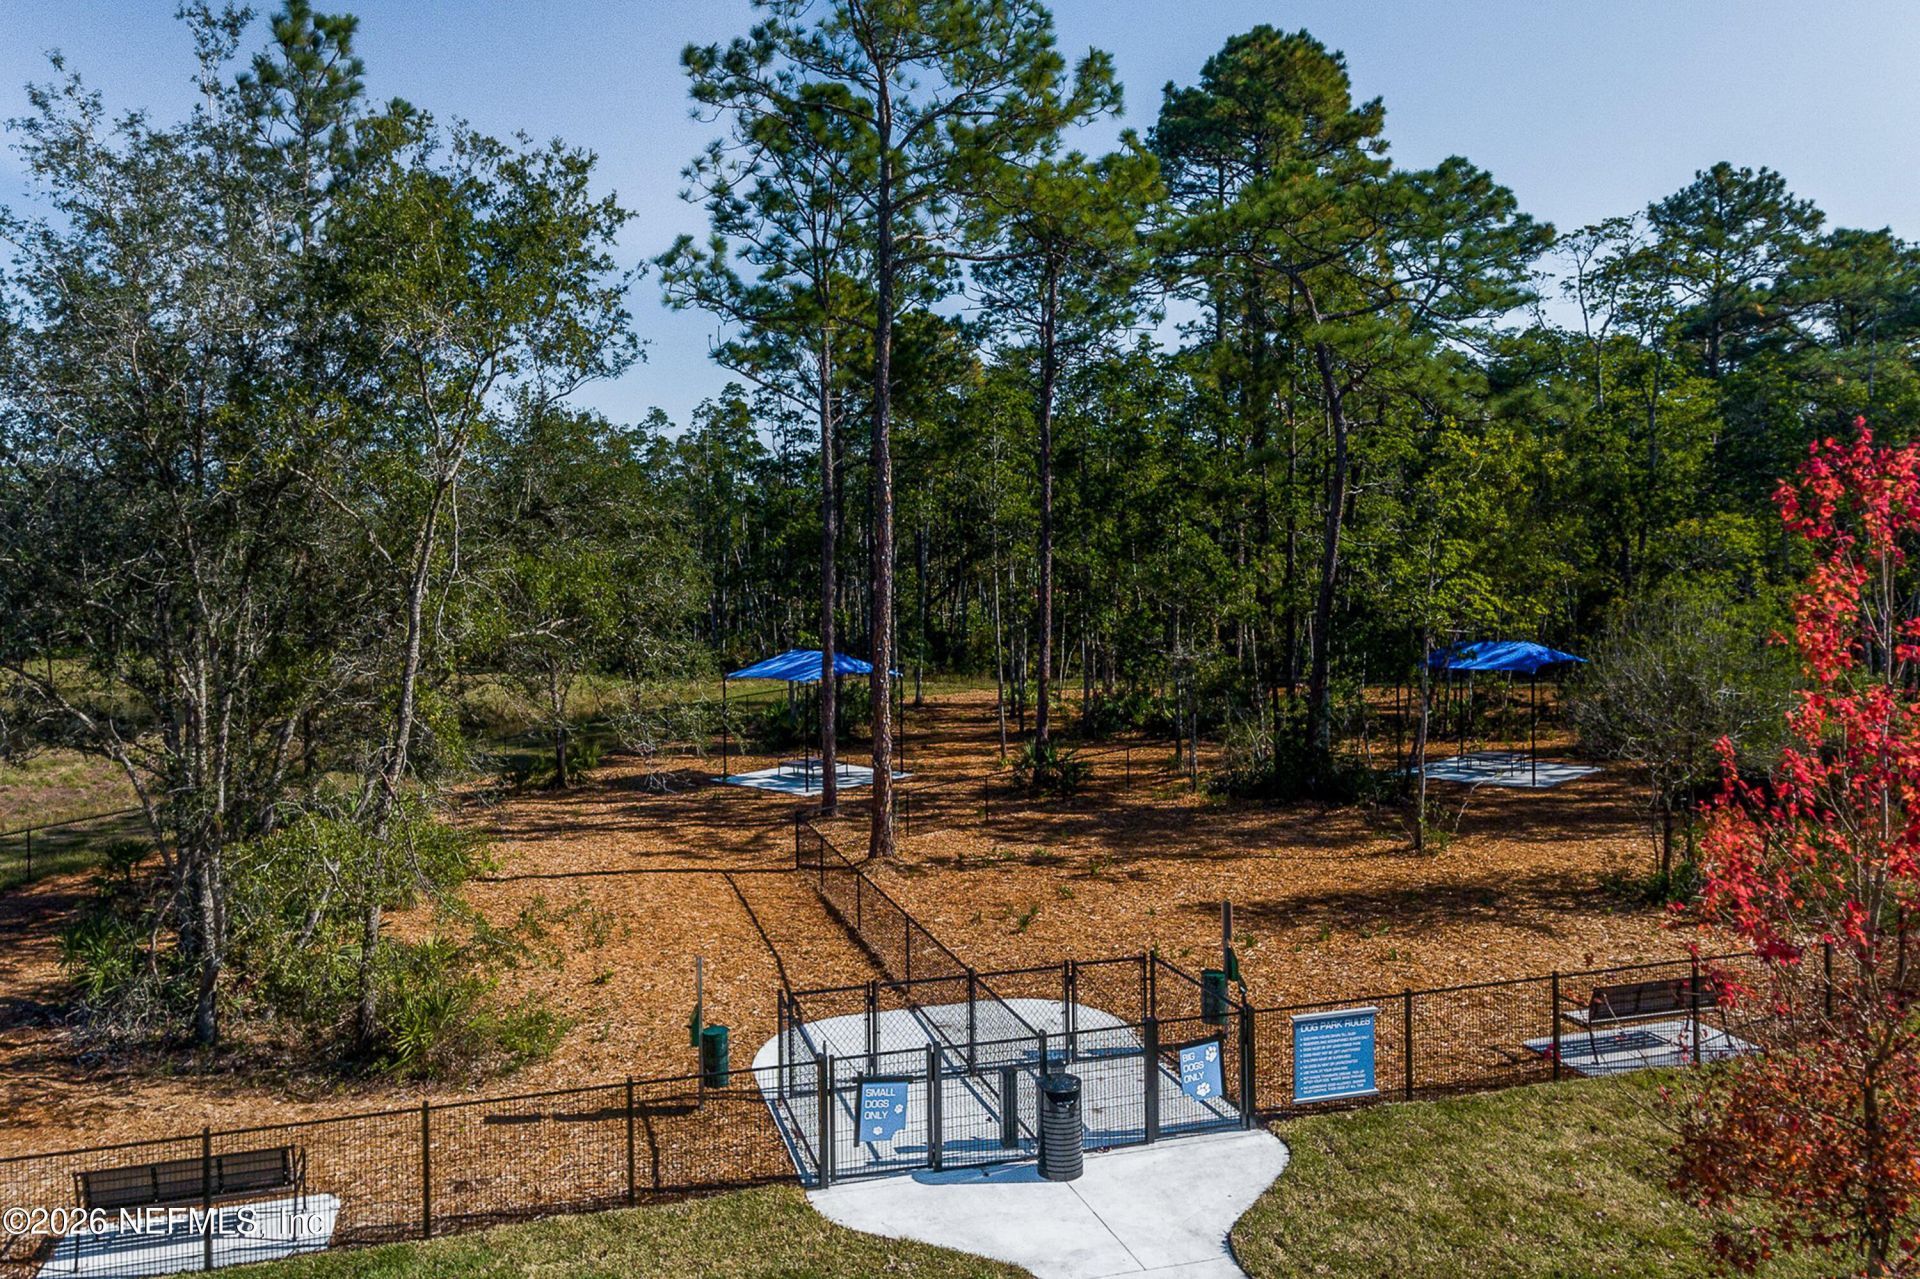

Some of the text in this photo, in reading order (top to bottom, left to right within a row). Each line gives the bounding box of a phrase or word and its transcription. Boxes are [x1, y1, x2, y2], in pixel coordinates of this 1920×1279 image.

[1301, 1017, 1370, 1033] DOG PARK RULES
[1182, 1052, 1195, 1062] BIG
[1183, 1060, 1204, 1073] DOGS
[1184, 1071, 1204, 1084] ONLY
[865, 1088, 896, 1097] SMALL
[865, 1099, 889, 1108] DOGS
[864, 1110, 888, 1120] ONLY
